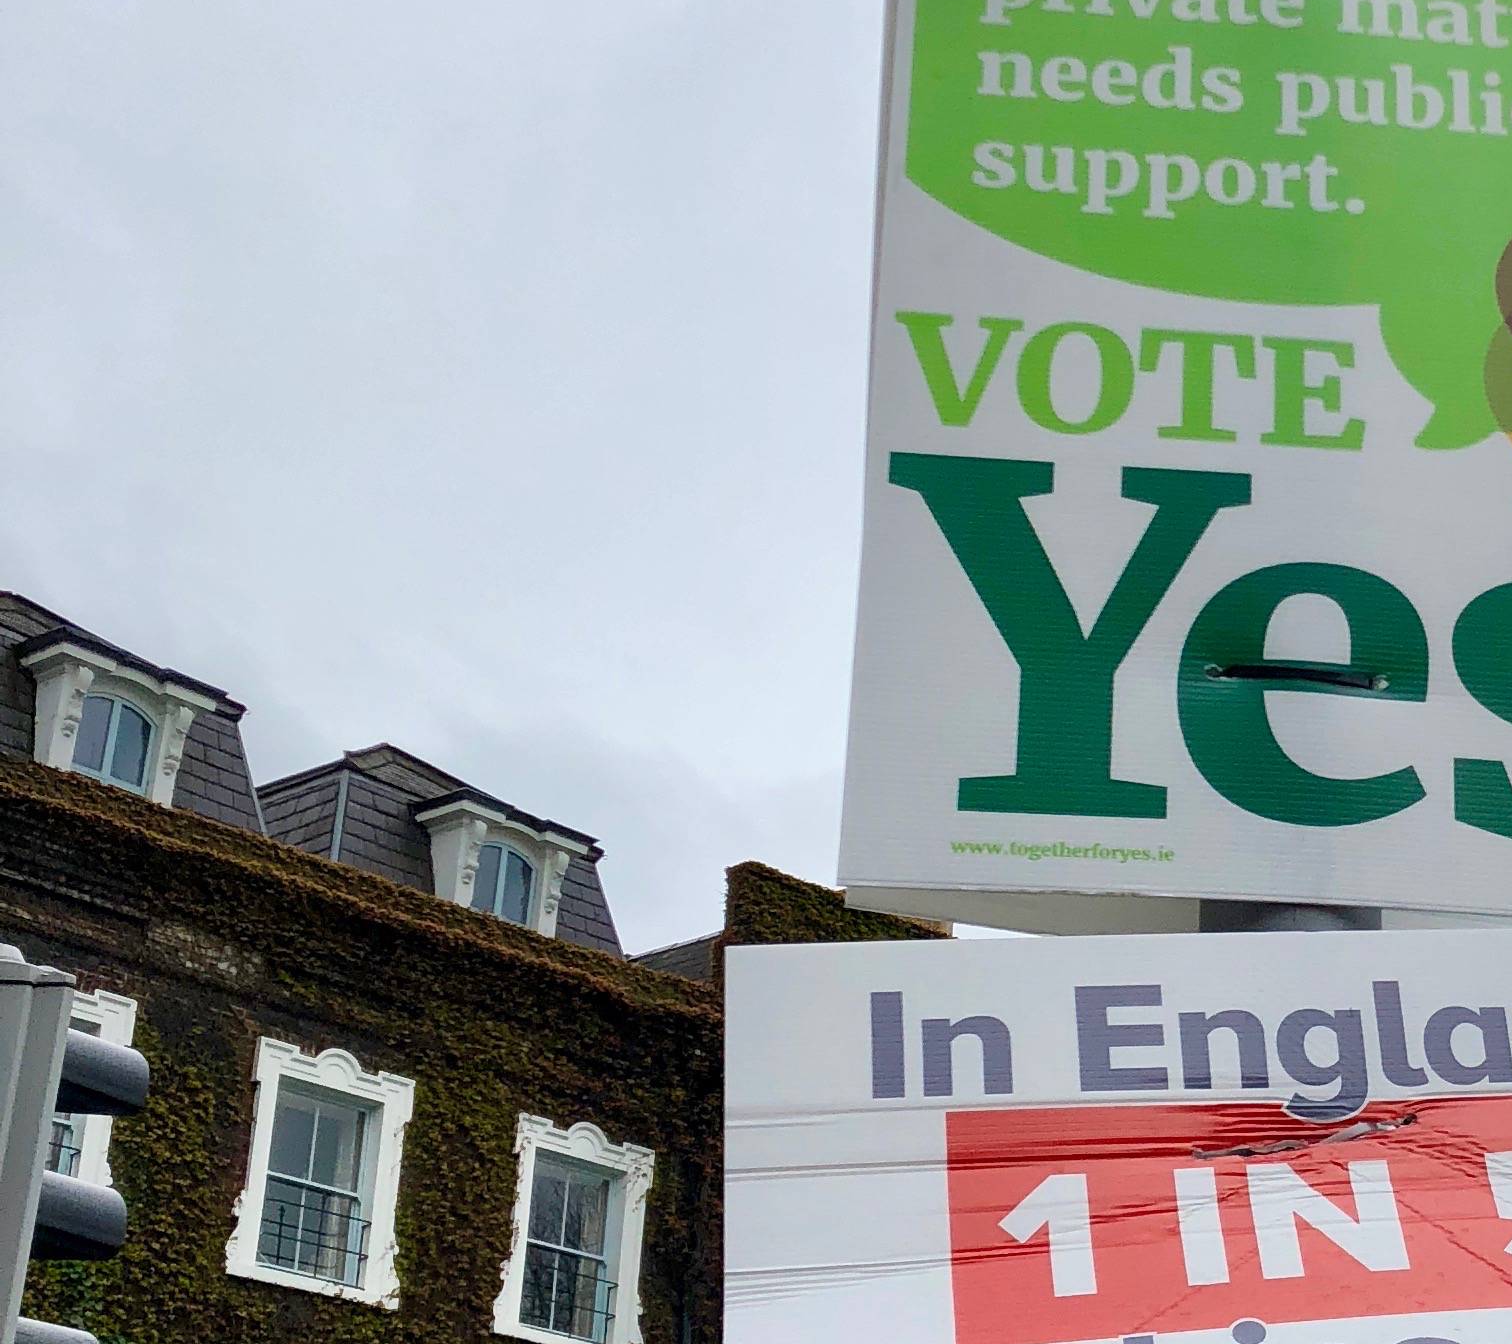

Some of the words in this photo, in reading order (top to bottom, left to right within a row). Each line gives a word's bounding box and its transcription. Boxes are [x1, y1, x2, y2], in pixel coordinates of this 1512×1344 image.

[976, 45, 1244, 114] needs
[971, 139, 1367, 220] support.
[894, 310, 1366, 452] VOTE
[950, 841, 1176, 864] www.togetherforyes.ie
[870, 990, 1014, 1100] In
[997, 1173, 1098, 1298] 1
[1172, 1159, 1411, 1288] IN
